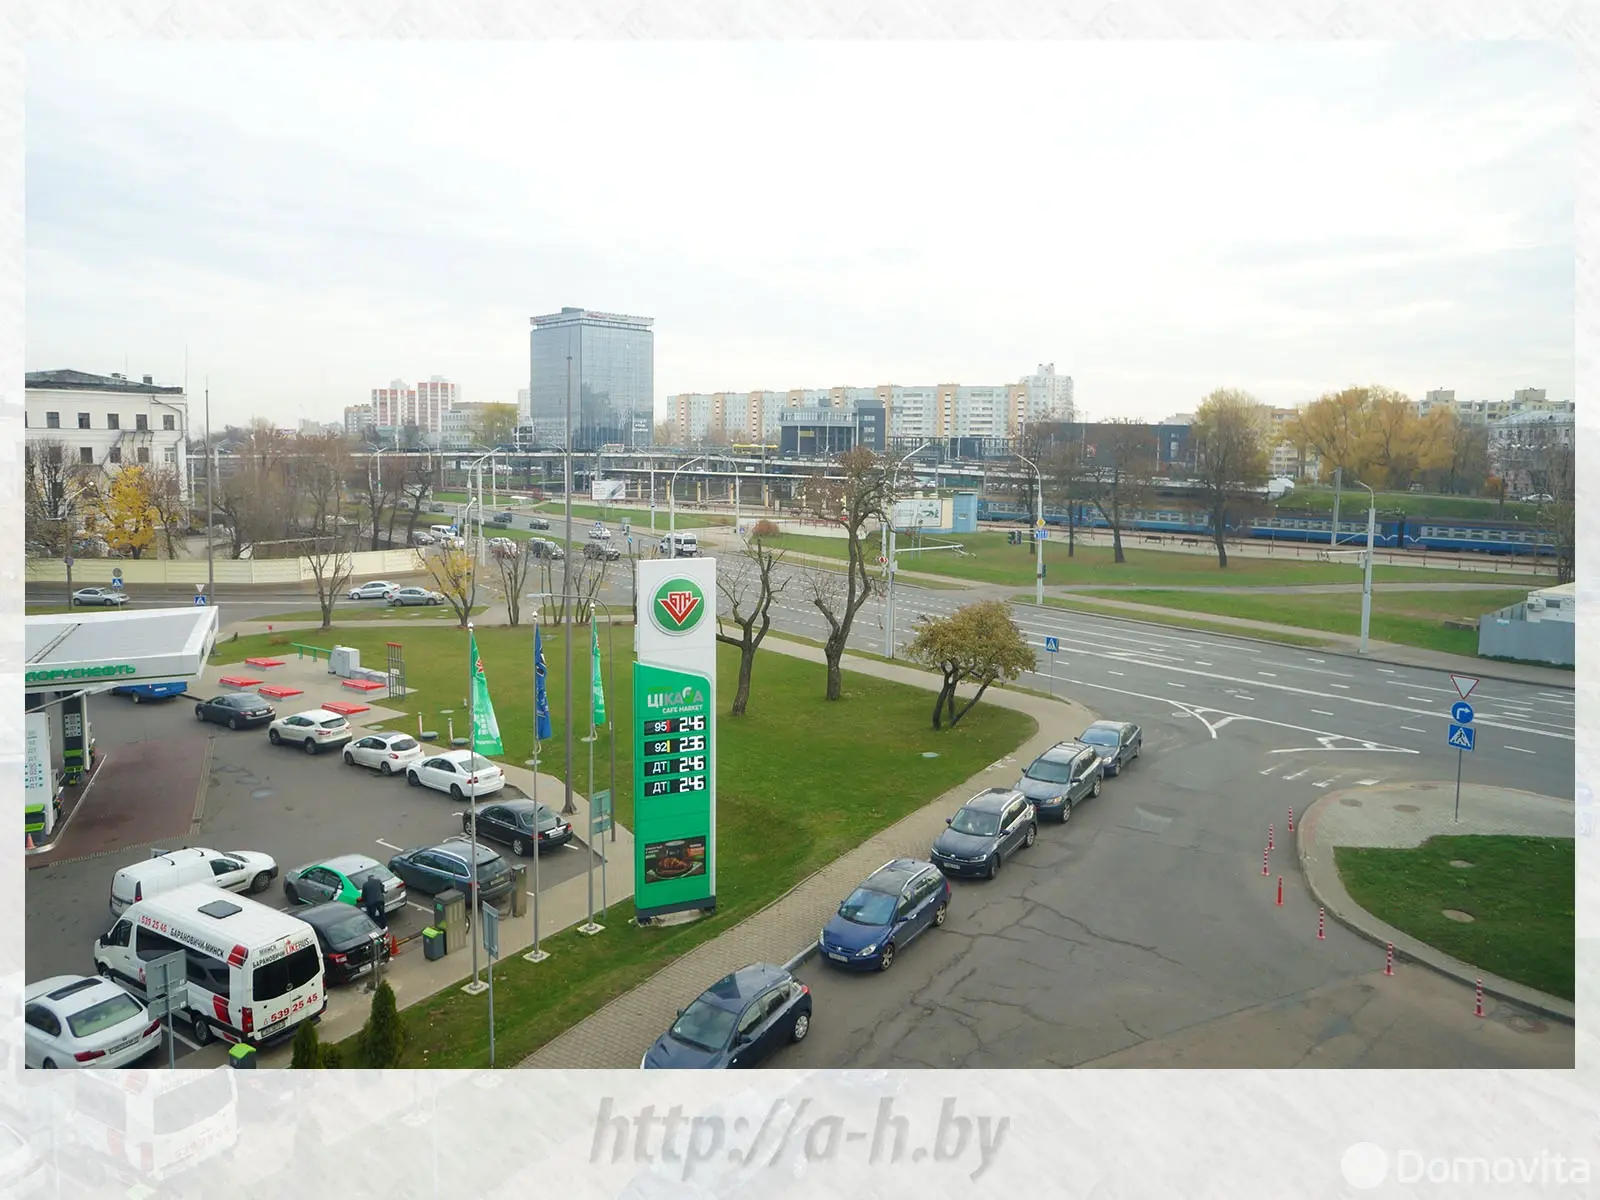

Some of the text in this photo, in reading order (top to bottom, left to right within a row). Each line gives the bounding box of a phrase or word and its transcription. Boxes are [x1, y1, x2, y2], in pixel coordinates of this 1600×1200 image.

[679, 704, 703, 713] MARKET
[654, 715, 704, 732] 95 246
[654, 735, 704, 752] 92 236
[652, 755, 704, 774] ДТ 246
[652, 775, 704, 794] ДТ 246
[141, 915, 152, 927] 539
[270, 992, 318, 1022] 539 25 45
